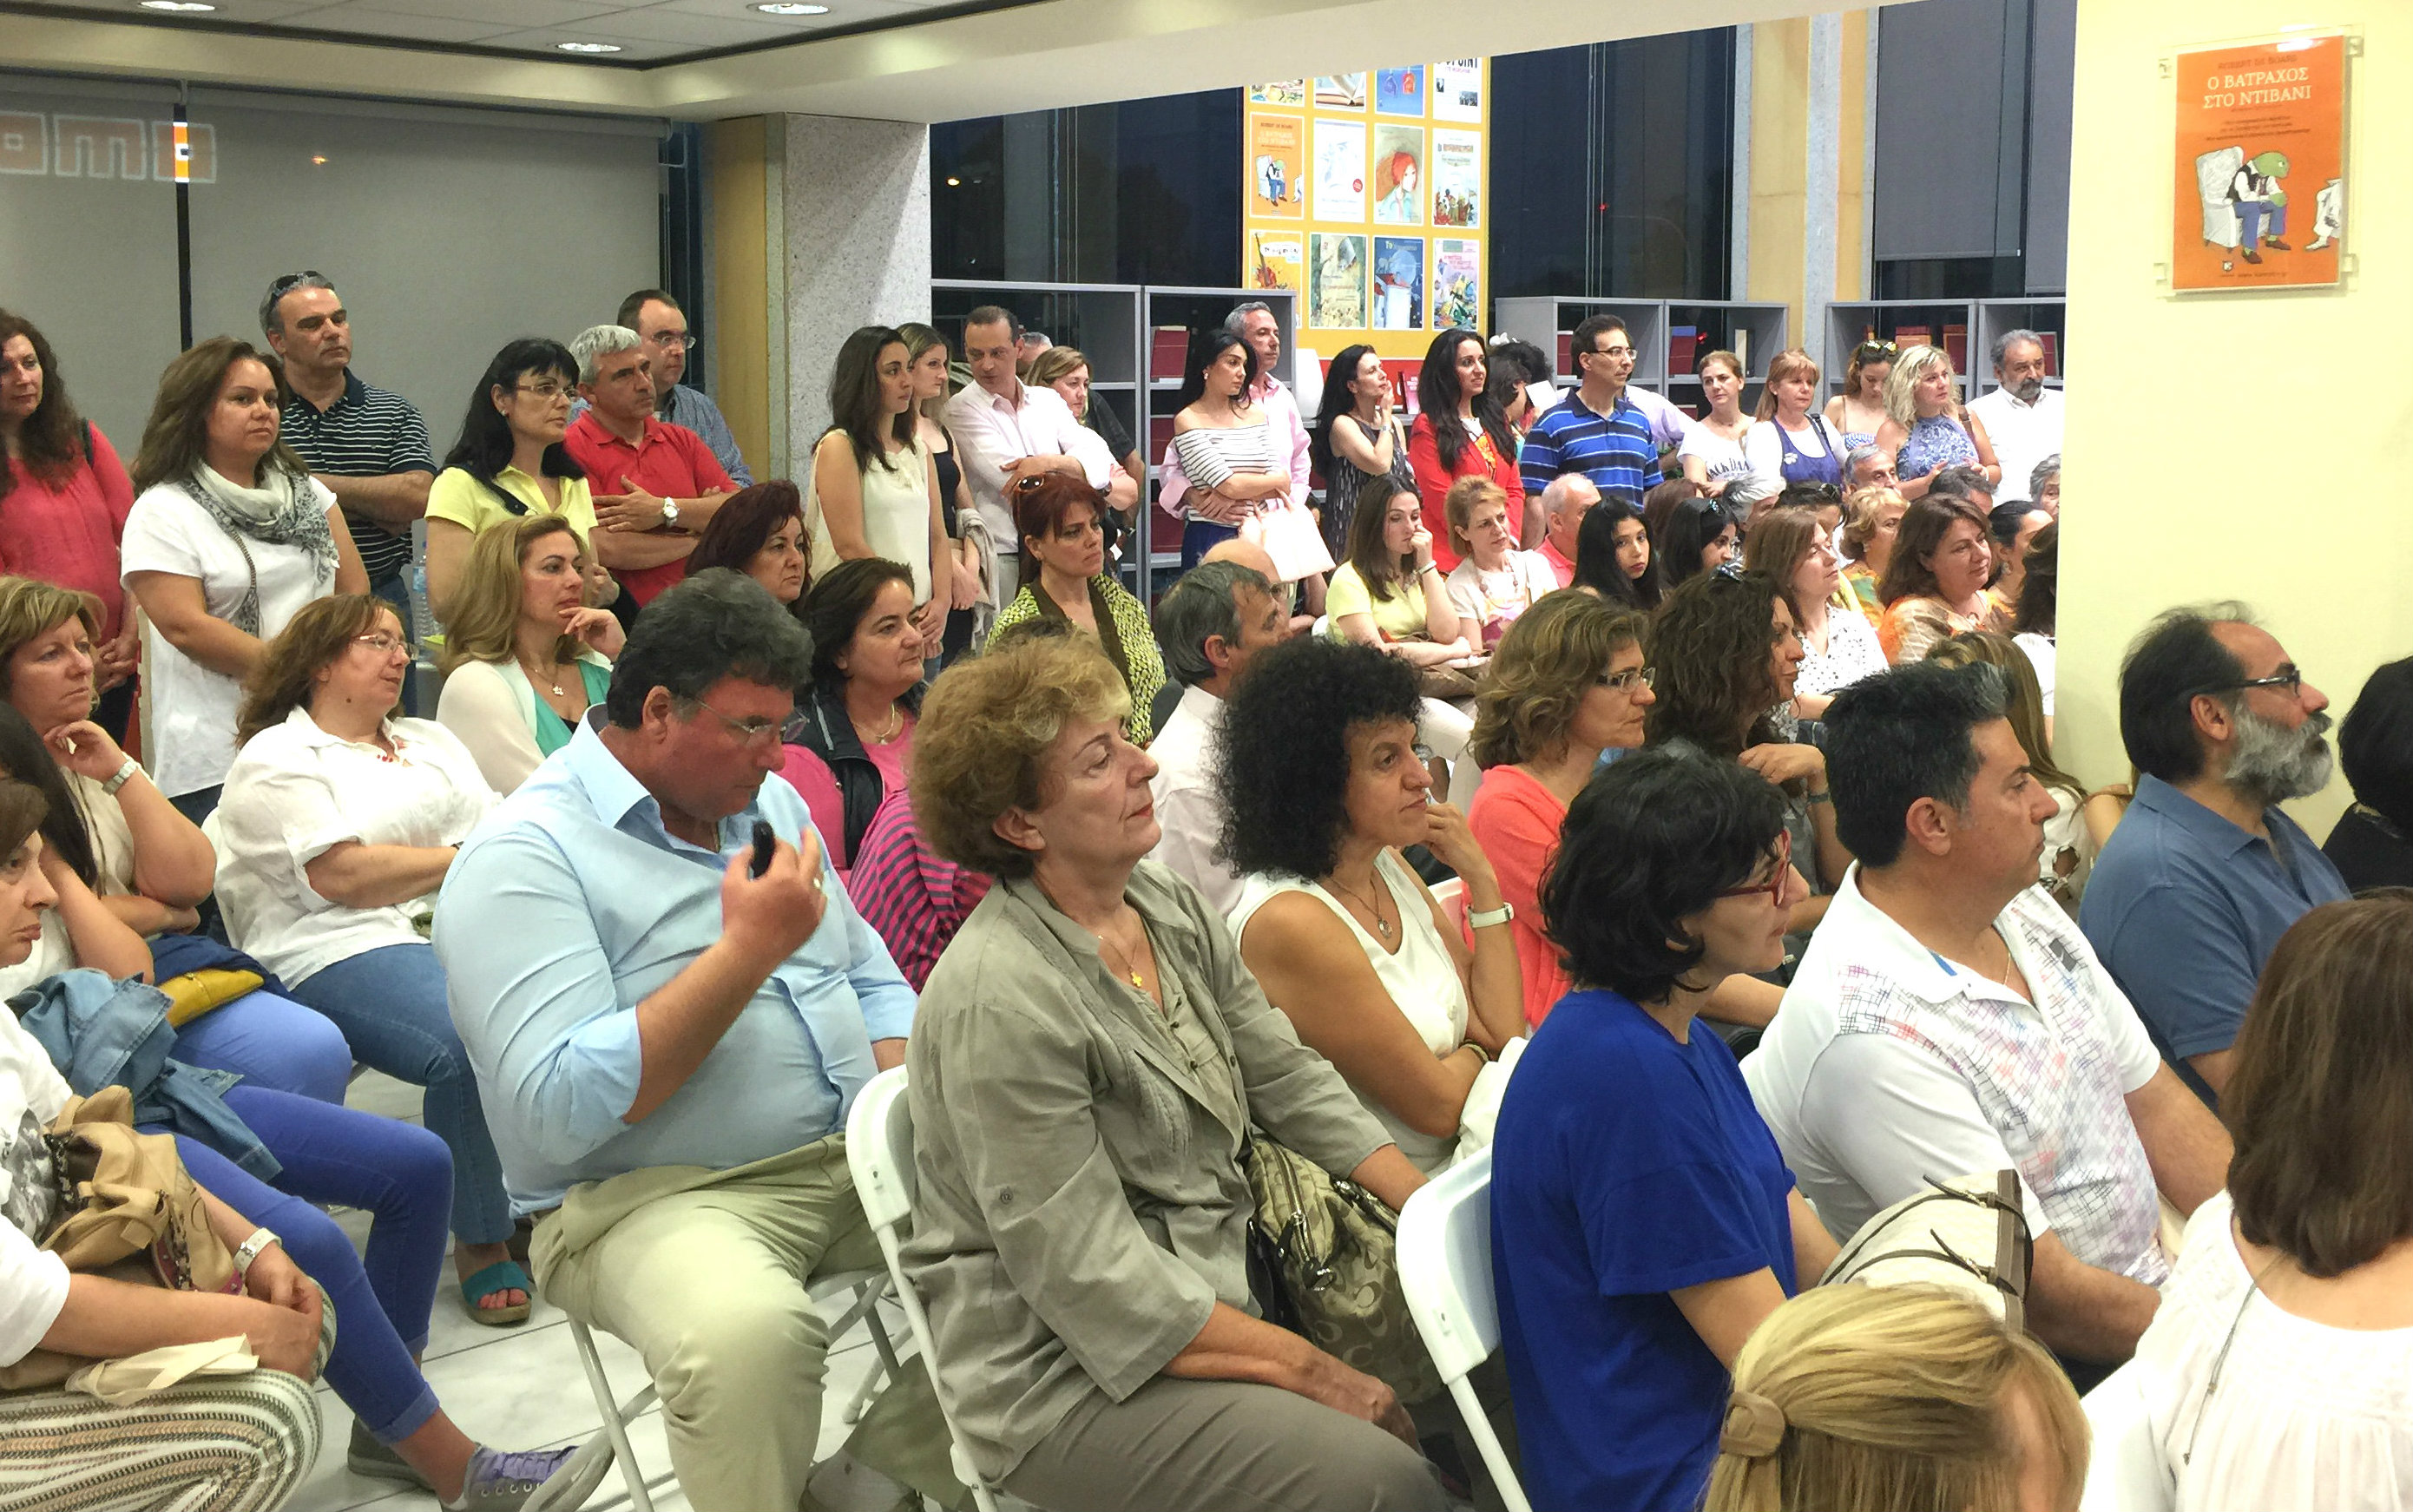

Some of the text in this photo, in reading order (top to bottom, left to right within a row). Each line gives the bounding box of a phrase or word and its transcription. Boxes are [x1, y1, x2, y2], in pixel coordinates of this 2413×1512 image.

[2207, 67, 2309, 90] Ο ΒΑΤΡΑΧΟΣ
[2203, 93, 2235, 109] ΣΤΟ
[2239, 85, 2312, 106] ΝΤΙΒΑΝΙ
